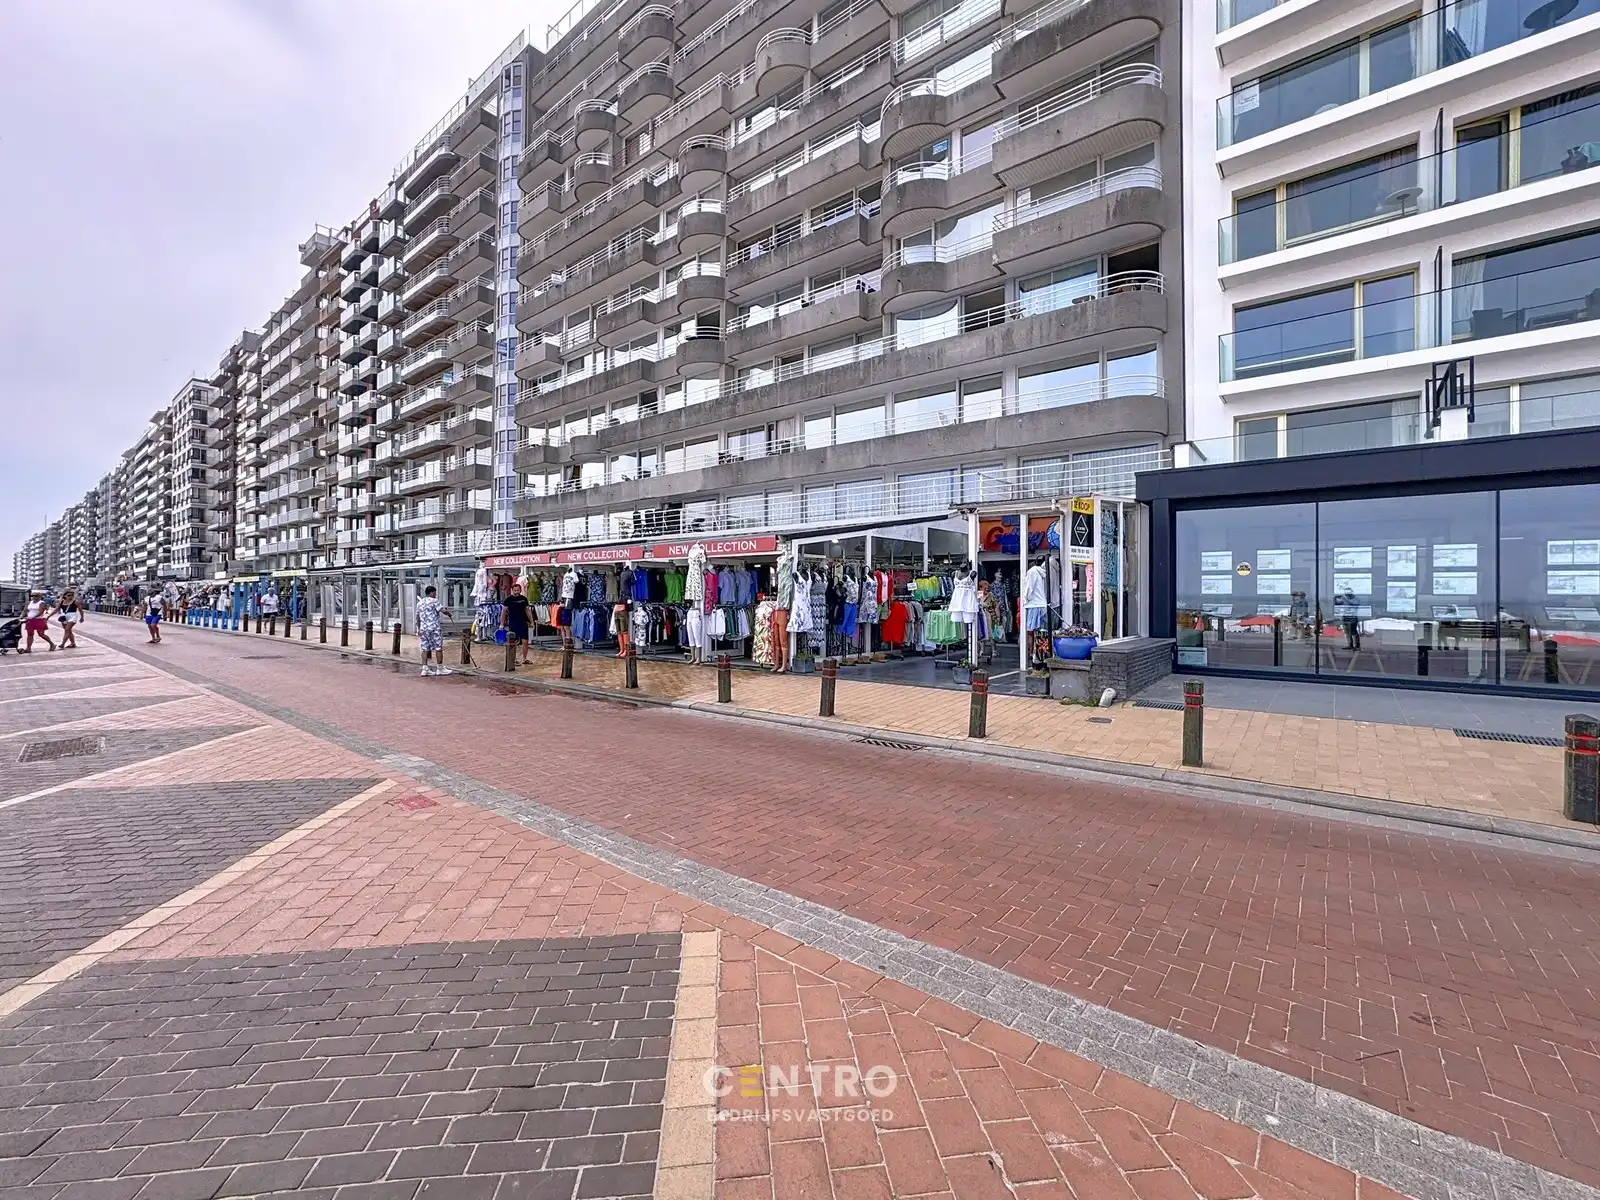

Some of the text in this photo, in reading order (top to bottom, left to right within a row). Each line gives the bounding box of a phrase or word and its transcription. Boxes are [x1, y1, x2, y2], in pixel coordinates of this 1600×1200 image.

[668, 540, 757, 555] NEW OLLECTION
[493, 555, 541, 565] NEW COLLECTION
[567, 549, 630, 561] NEW COLLECTION
